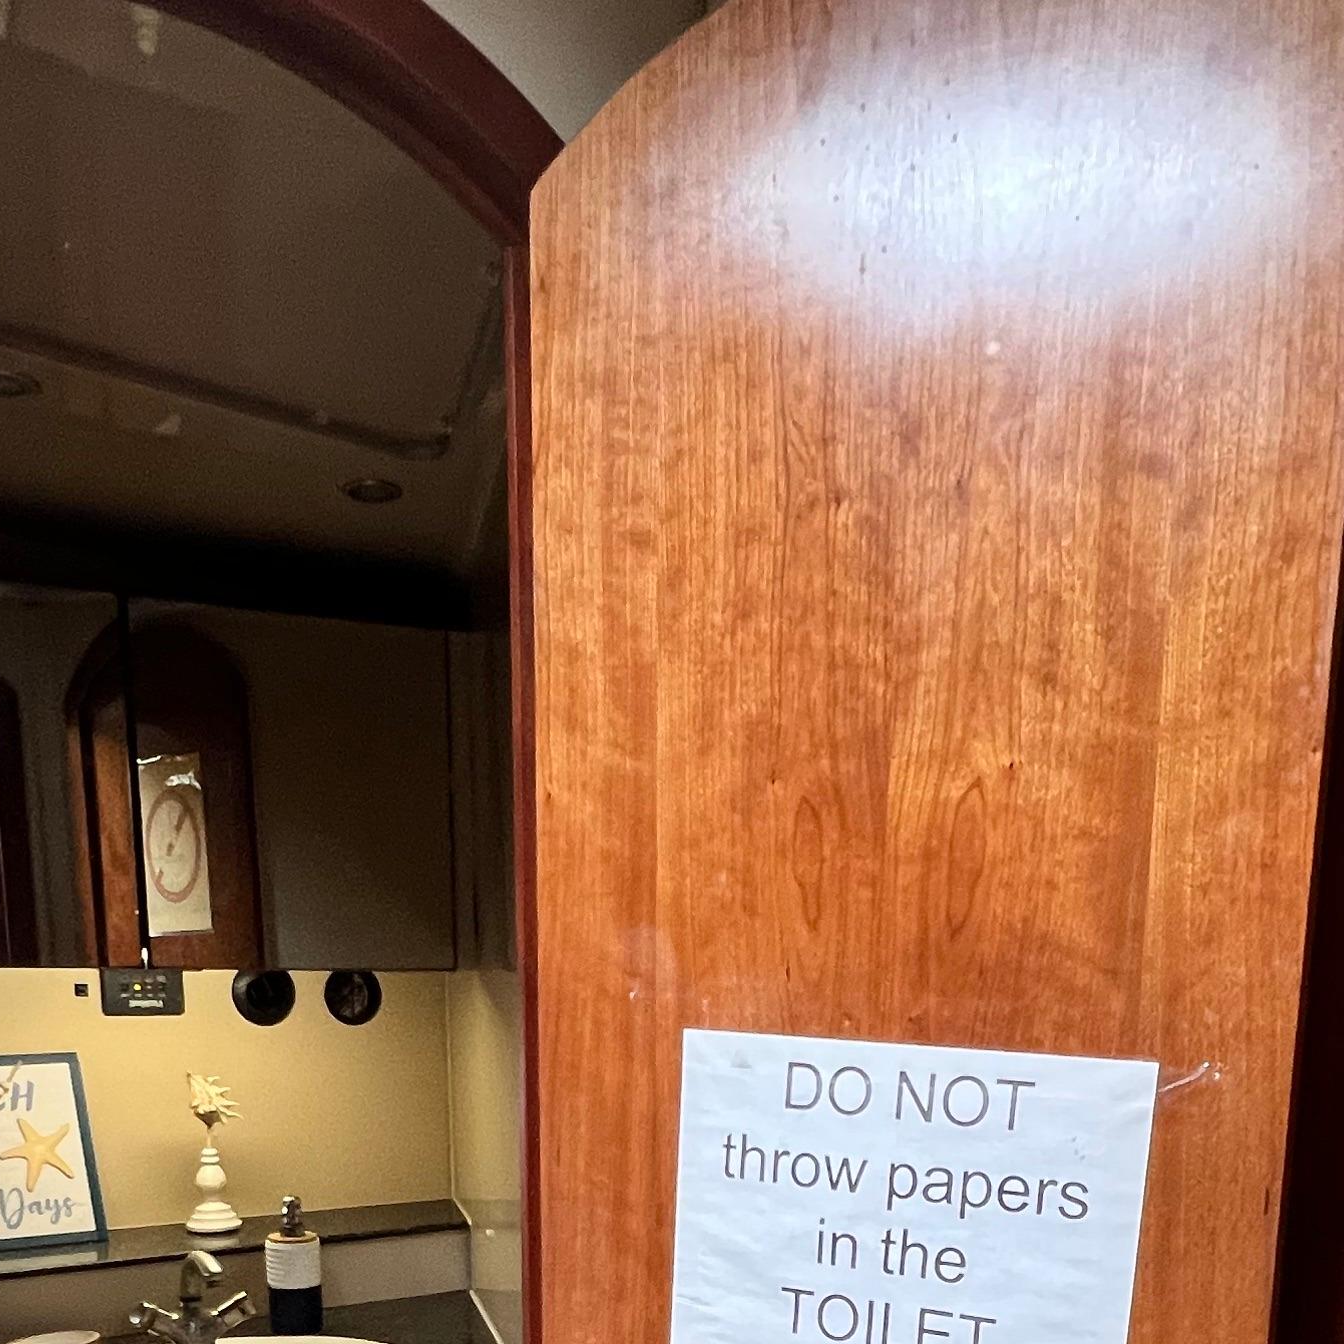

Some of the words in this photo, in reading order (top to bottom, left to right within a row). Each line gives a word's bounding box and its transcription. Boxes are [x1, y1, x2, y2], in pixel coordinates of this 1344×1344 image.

[784, 1061, 873, 1115] DO
[894, 1071, 1036, 1131] NOT
[722, 1133, 869, 1193] throw
[886, 1161, 1090, 1220] papers
[816, 1218, 858, 1269] in
[881, 1228, 967, 1283] the
